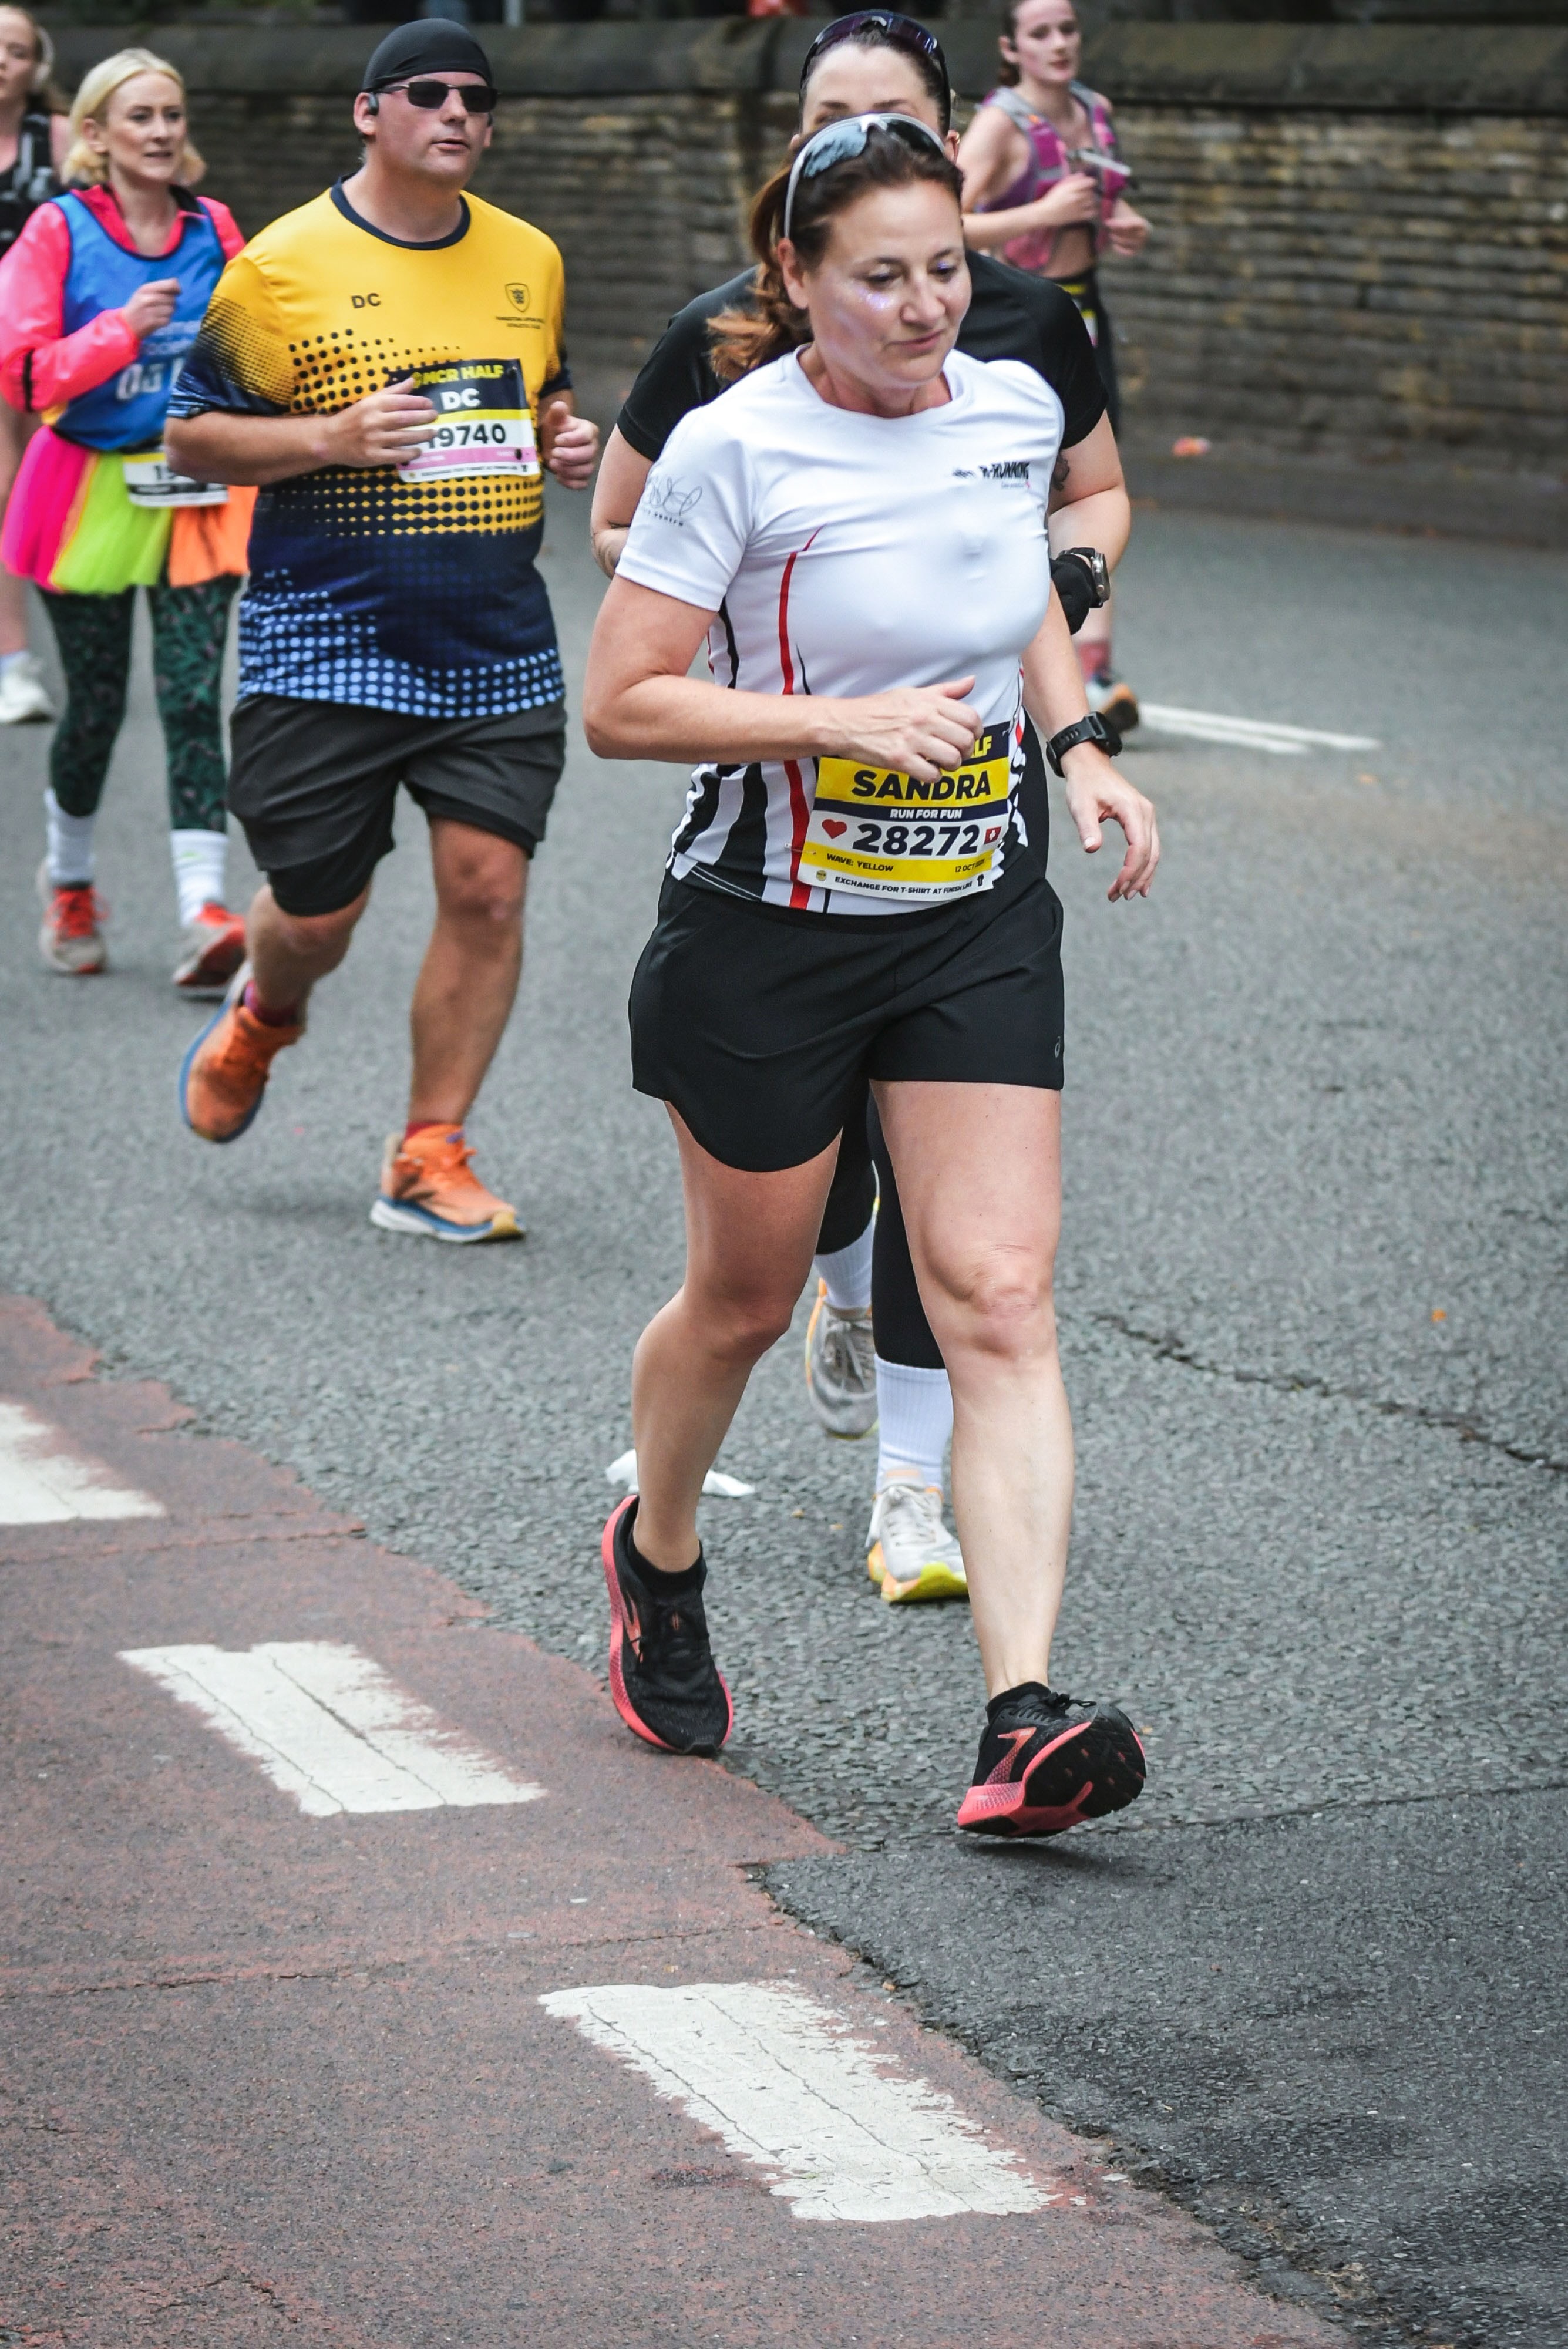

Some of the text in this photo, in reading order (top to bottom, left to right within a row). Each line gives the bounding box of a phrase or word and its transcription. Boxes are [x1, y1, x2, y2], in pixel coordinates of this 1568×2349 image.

[351, 292, 381, 309] DC
[422, 364, 504, 385] MCR HALF
[439, 388, 482, 410] DC
[970, 735, 992, 759] LF
[852, 769, 991, 800] SANDRA
[890, 809, 963, 819] RUN FOR FUN
[852, 823, 980, 856] 28272
[827, 853, 894, 872] WAVE: YELLOW
[962, 863, 975, 871] OCT
[835, 876, 881, 891] EXCHANGE
[881, 884, 899, 893] FOR
